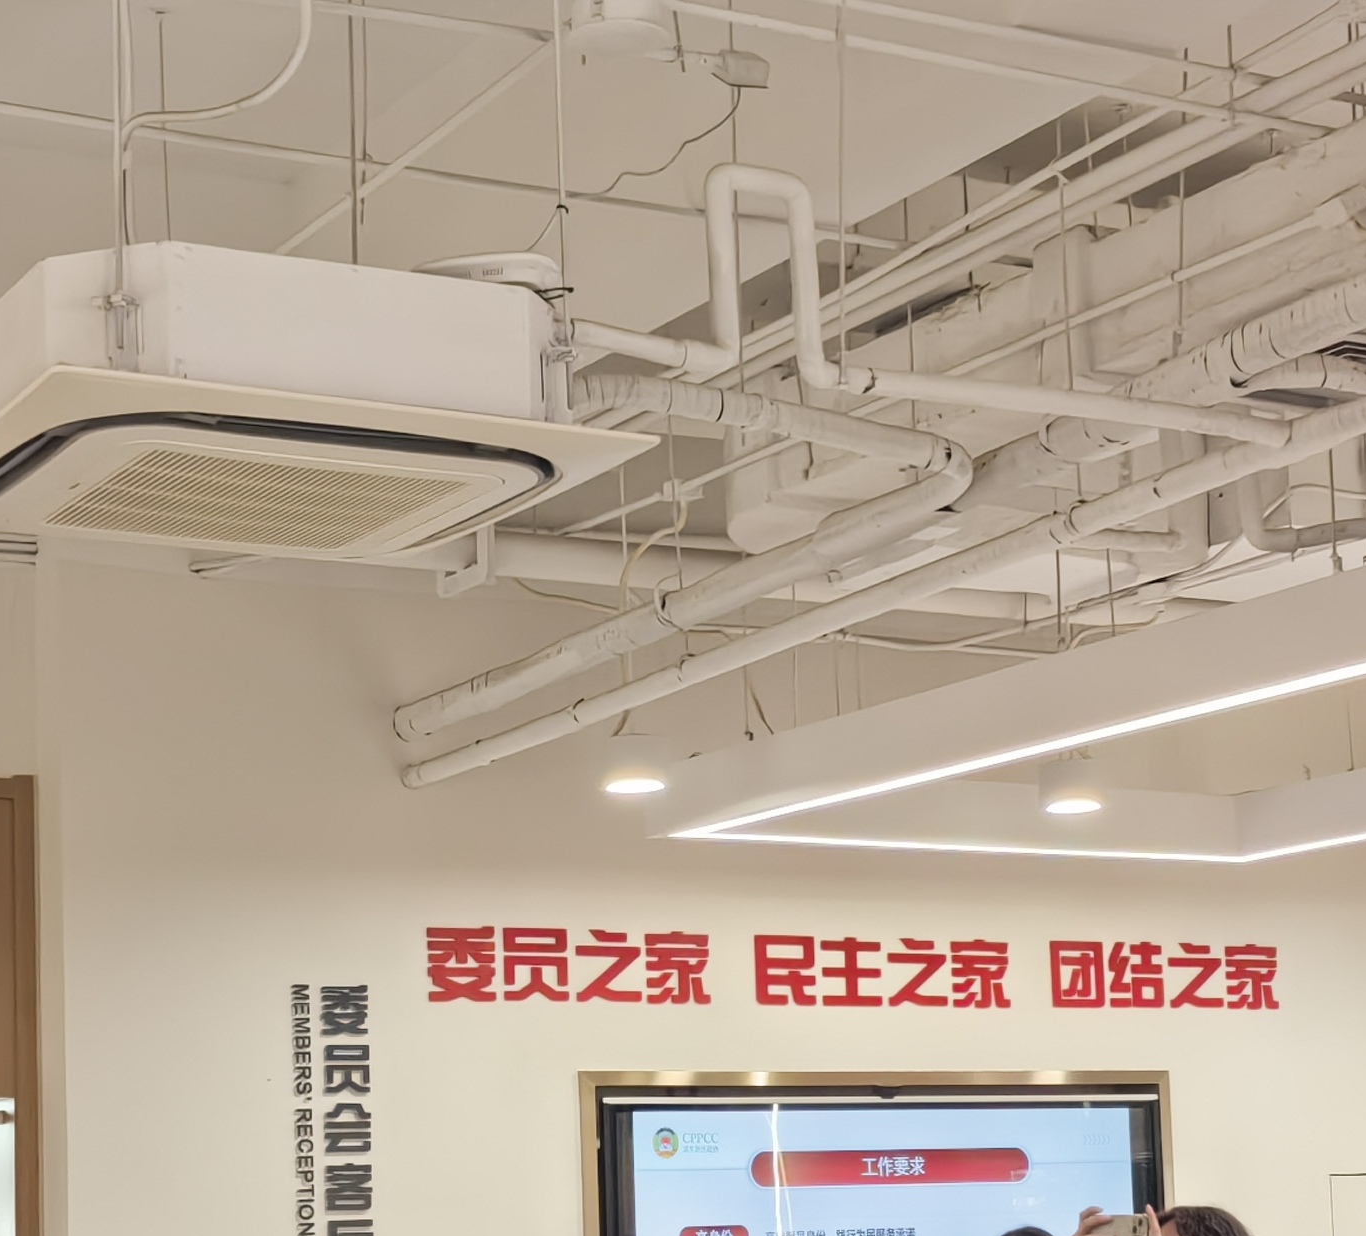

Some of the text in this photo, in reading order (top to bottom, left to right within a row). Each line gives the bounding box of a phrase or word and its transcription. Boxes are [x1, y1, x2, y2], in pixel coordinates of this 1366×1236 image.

[427, 927, 1278, 1009] 委员之家 民主之家 团结之家
[291, 984, 312, 1102] MEMBERS'
[295, 1108, 315, 1236] RECEPTION
[682, 1133, 719, 1143] CPPCC
[861, 1156, 925, 1177] 工作要求
